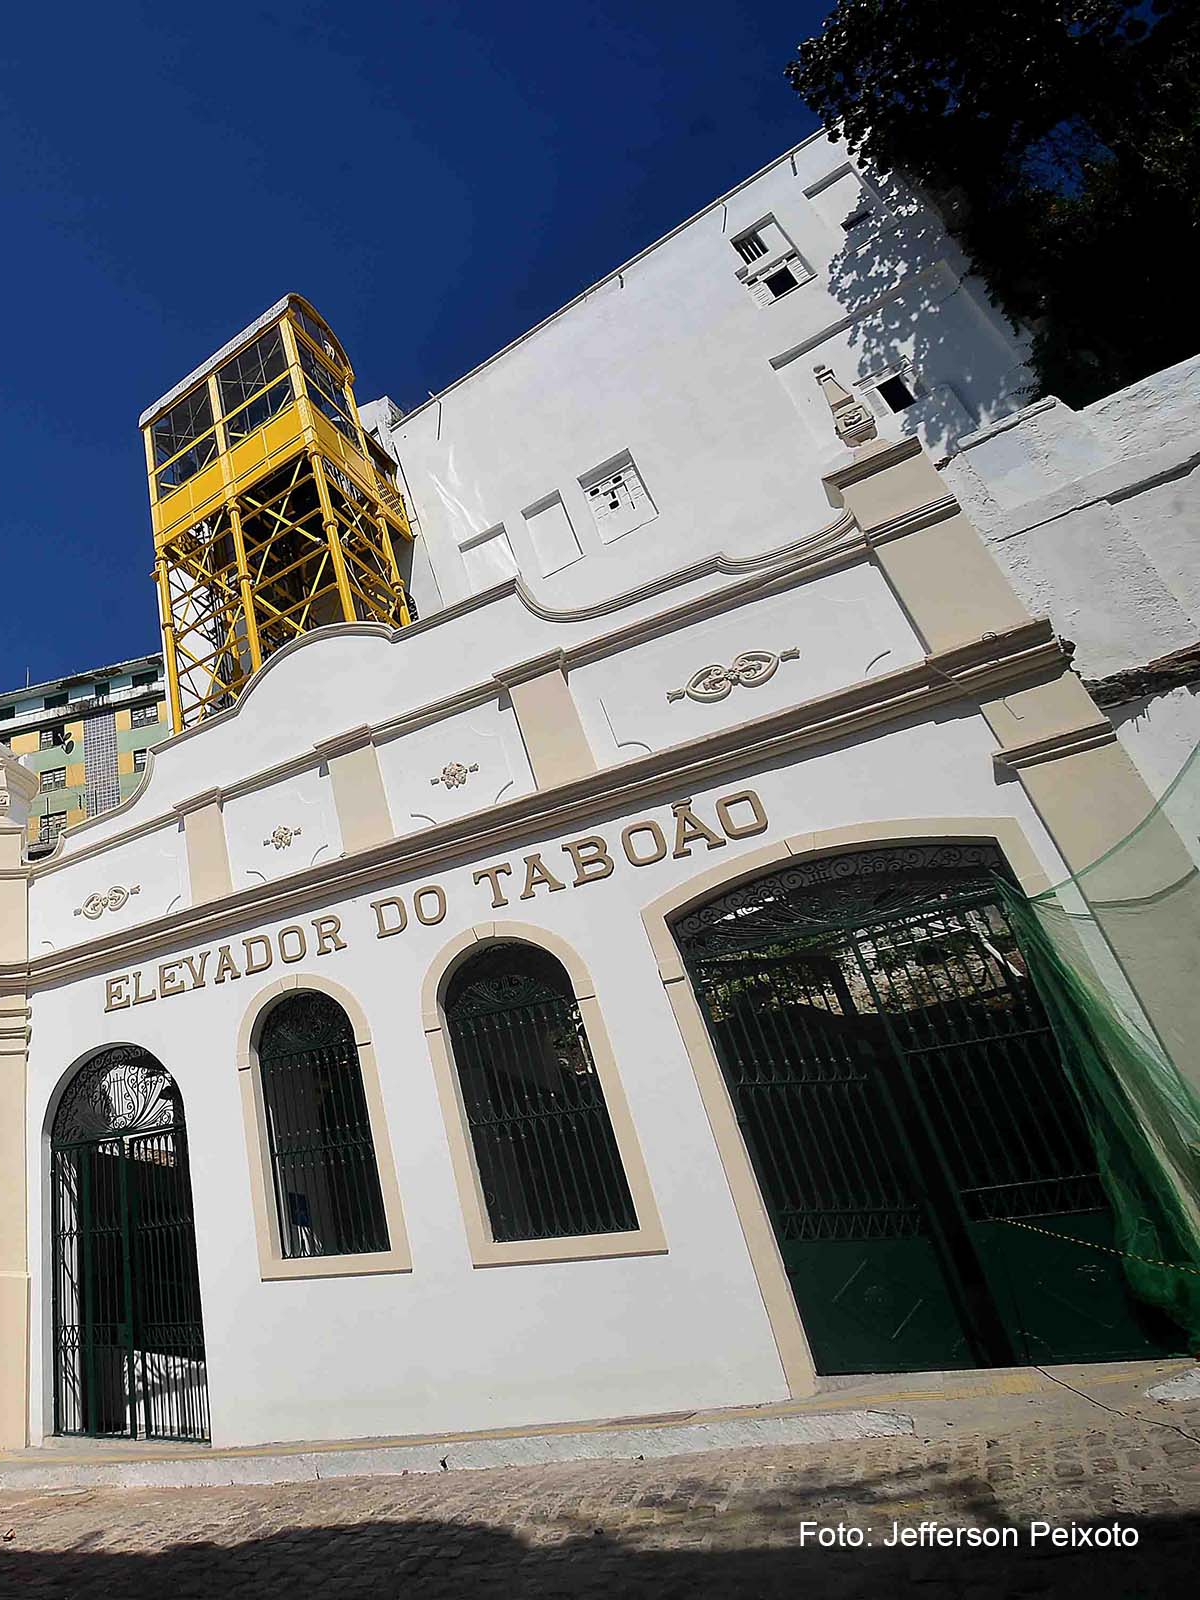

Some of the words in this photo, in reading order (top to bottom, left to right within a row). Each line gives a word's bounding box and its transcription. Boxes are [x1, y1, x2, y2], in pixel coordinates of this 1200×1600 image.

[104, 912, 347, 1012] ELEVADOR
[371, 885, 446, 938] DO
[474, 790, 768, 908] TABOÃO
